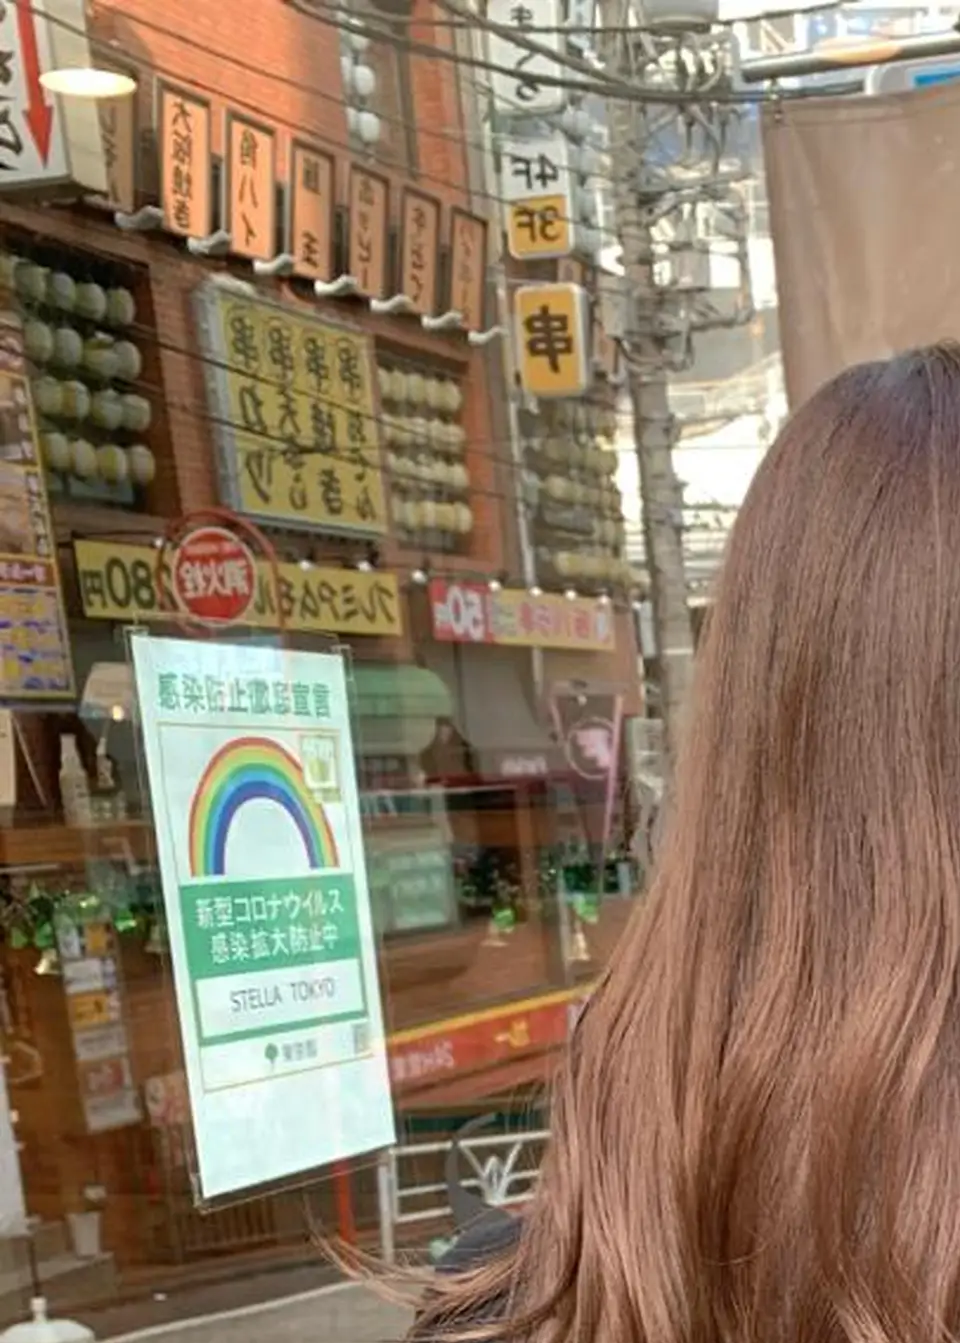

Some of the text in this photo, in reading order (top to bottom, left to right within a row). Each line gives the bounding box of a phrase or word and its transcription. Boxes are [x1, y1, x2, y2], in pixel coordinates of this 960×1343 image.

[195, 889, 344, 929] 新型コロナウイルス
[211, 921, 340, 965] 感染拡大防止中
[229, 978, 337, 1014] STELLA TOKYO
